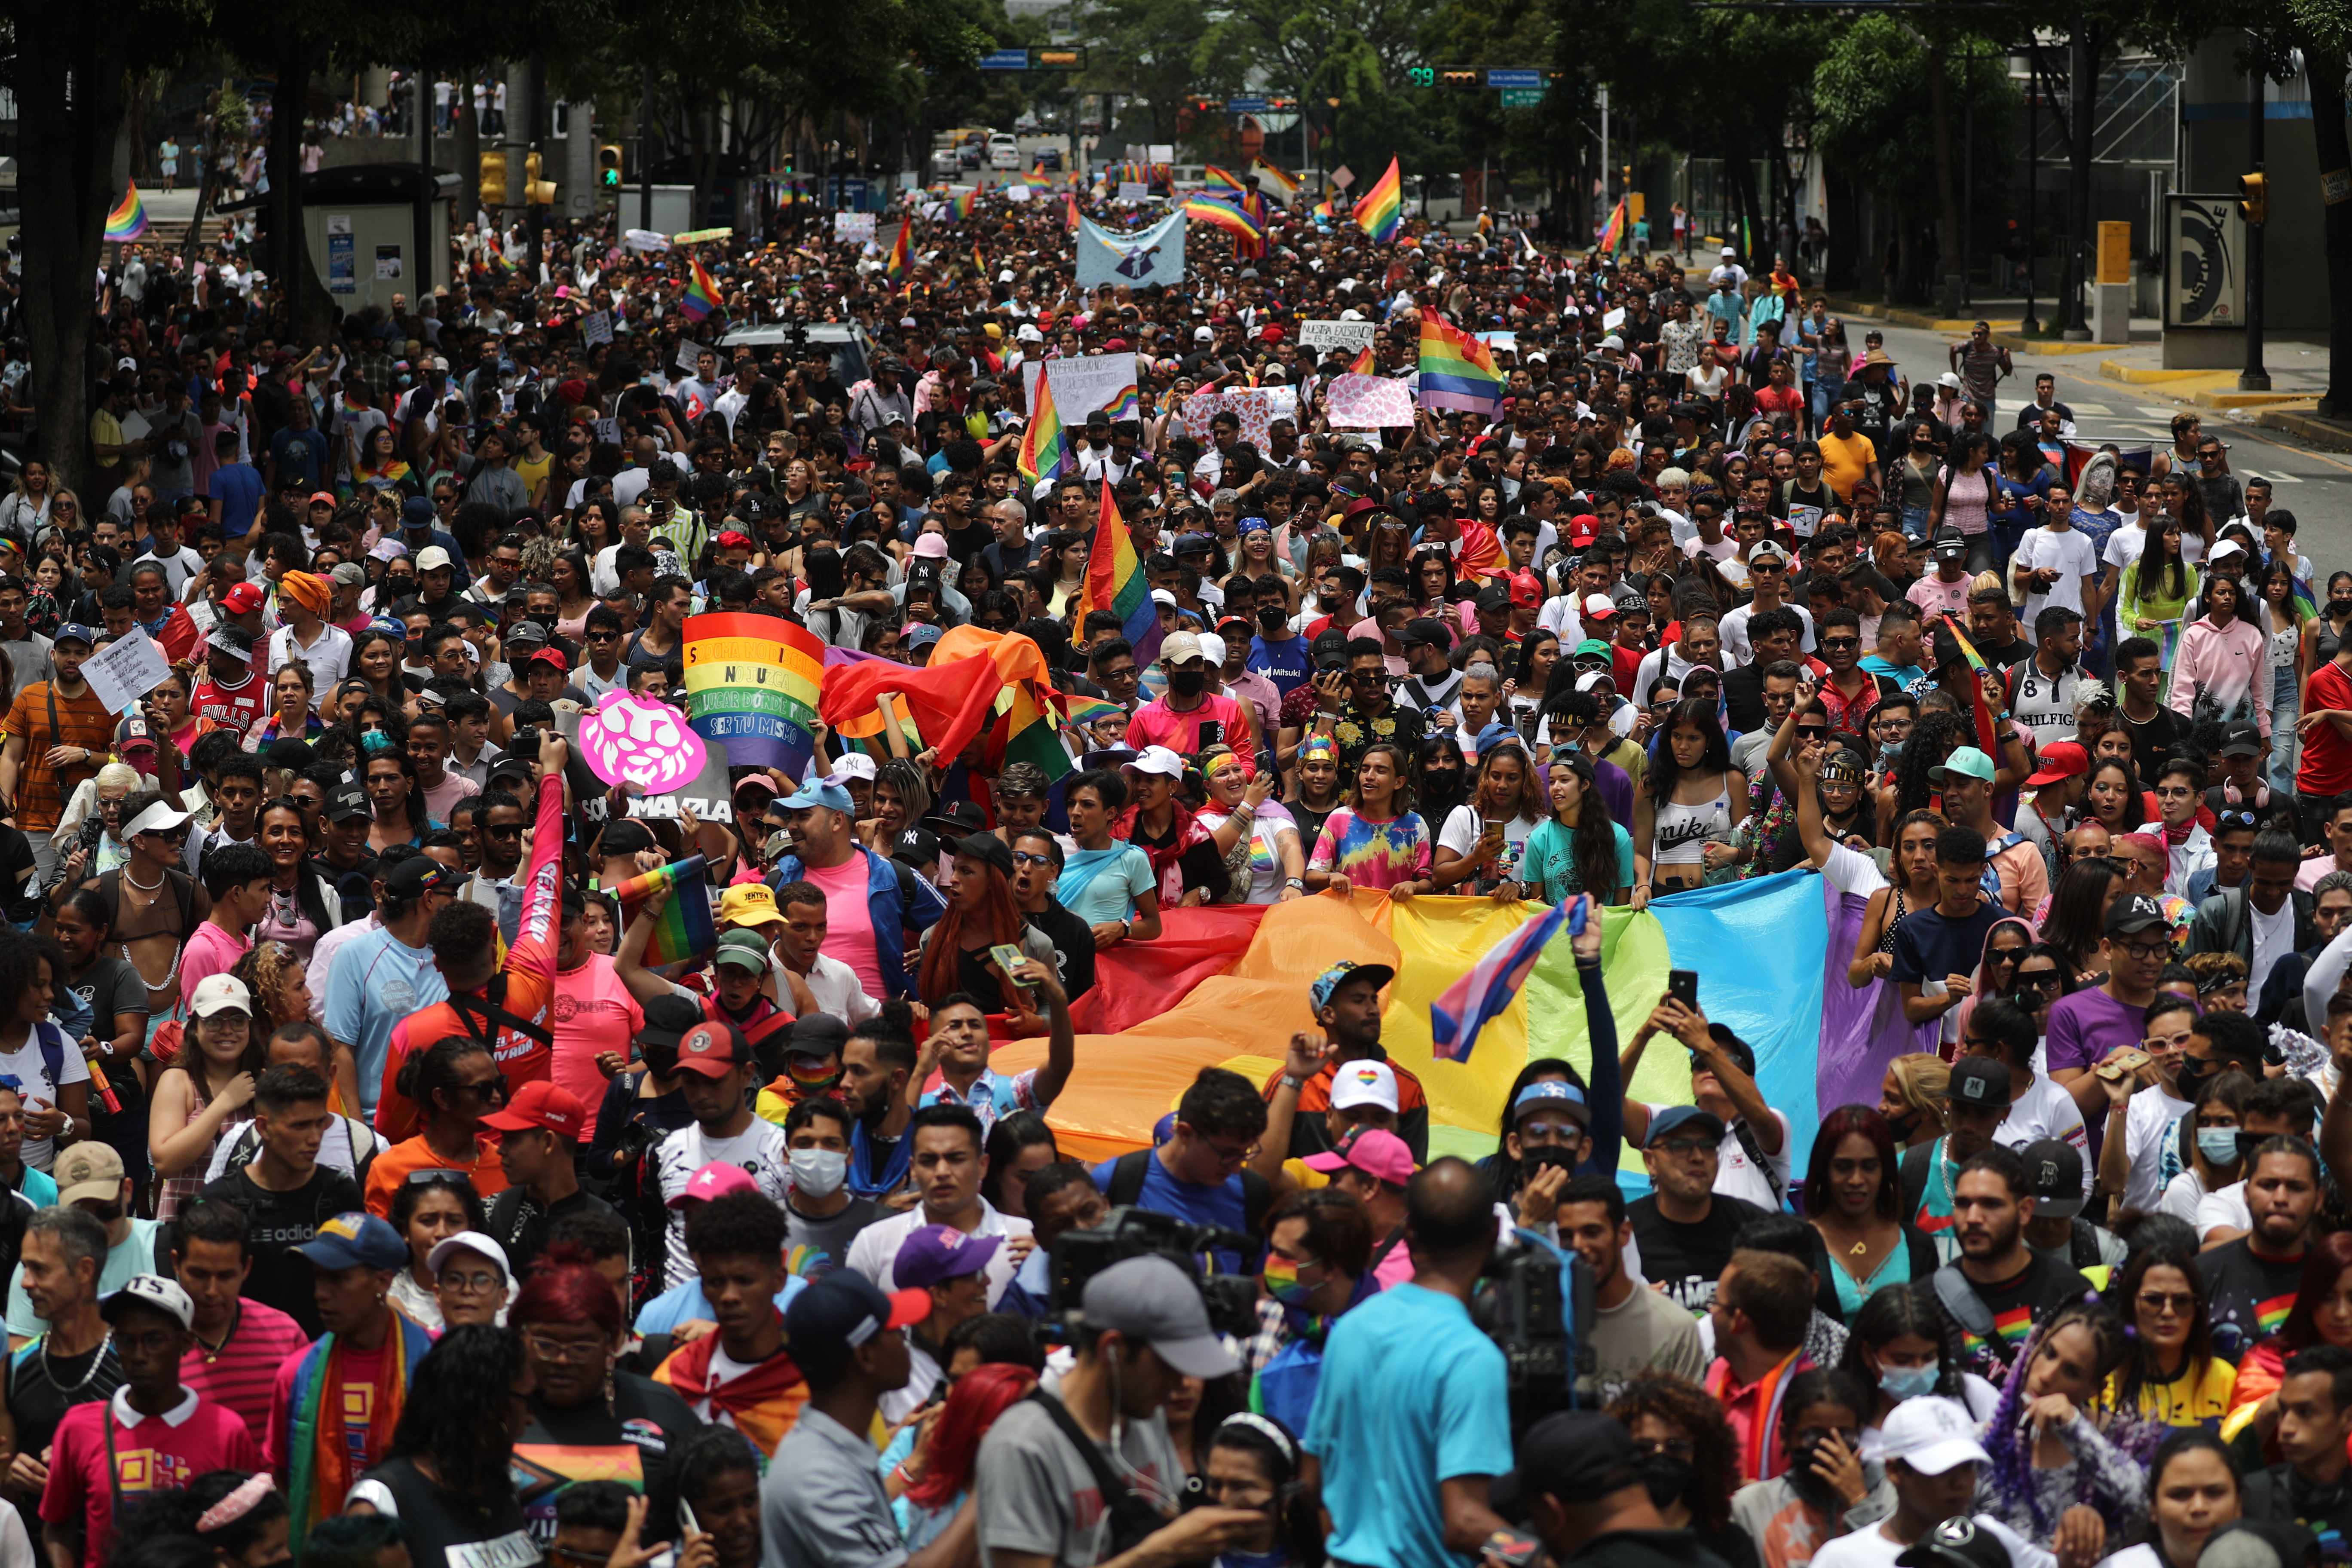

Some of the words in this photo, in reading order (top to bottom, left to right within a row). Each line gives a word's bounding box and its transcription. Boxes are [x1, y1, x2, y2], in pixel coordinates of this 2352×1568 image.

[1410, 67, 1434, 87] 99
[2186, 206, 2228, 314] DISPONIBLE
[1302, 325, 1332, 335] NUESTRA
[1767, 400, 1790, 410] CUBA
[750, 500, 760, 512] LA
[1581, 523, 1590, 535] LA
[433, 549, 445, 559] NY
[918, 565, 929, 578] NY
[1205, 603, 1218, 627] Wilson
[1179, 634, 1194, 647] NY
[691, 642, 740, 663] SODOMA
[745, 642, 766, 659] NO
[769, 645, 824, 685] DISCRIMINA
[726, 666, 744, 682] NO
[747, 667, 789, 691] JUZGA
[1272, 668, 1300, 678] Mitsuki
[2024, 680, 2037, 698] 8
[703, 691, 739, 711] LUGAR
[742, 689, 786, 714] DÓNDE
[201, 705, 251, 731] BULLS
[710, 717, 732, 735] SER
[734, 713, 754, 733] TÚ
[759, 717, 797, 744] MISMO
[845, 756, 859, 771] NY
[348, 793, 365, 807] NIKE
[780, 830, 790, 838] CA
[903, 829, 918, 845] NY
[744, 891, 769, 901] JEHYSON
[512, 1004, 547, 1043] PLCER
[275, 1223, 316, 1241] adid
